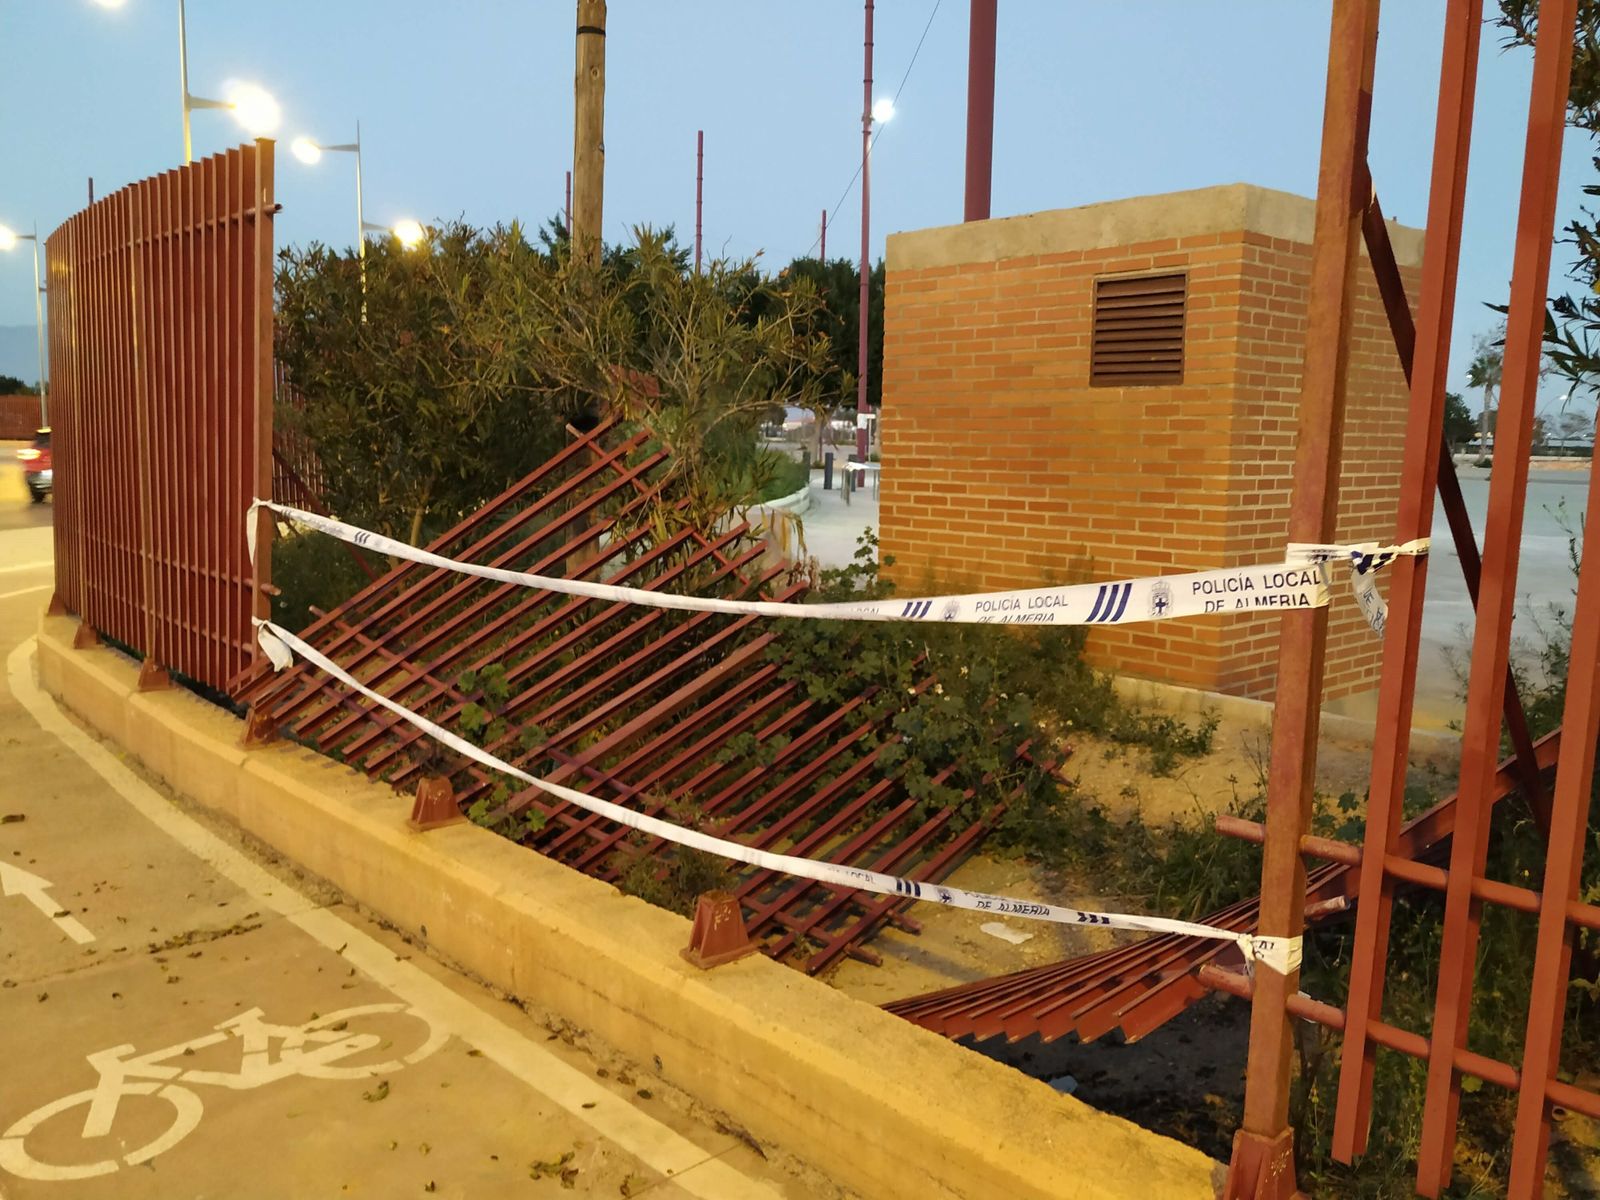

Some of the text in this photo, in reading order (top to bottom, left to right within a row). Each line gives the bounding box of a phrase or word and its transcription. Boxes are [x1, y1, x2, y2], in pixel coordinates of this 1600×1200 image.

[1192, 570, 1321, 595] POLICÍA LOCAL
[1028, 594, 1069, 609] LOCAL
